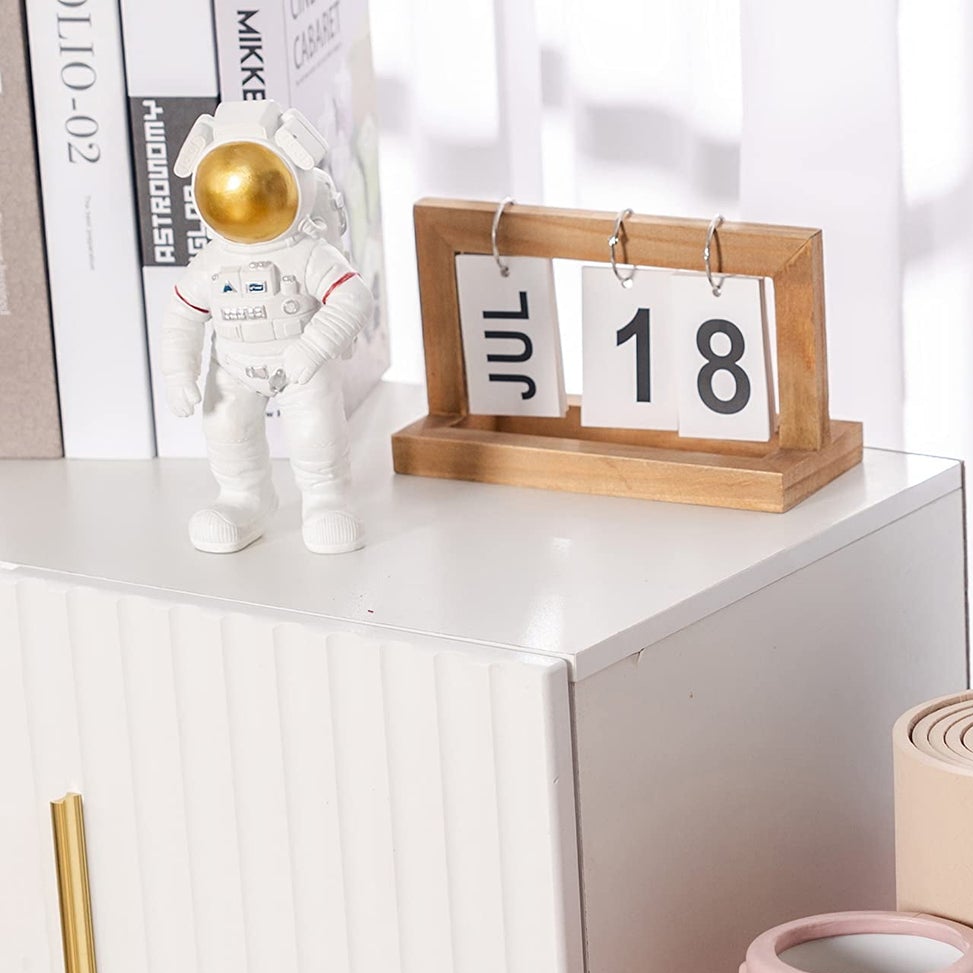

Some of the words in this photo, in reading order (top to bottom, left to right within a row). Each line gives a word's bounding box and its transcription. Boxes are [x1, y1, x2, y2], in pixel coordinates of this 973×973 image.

[56, 0, 102, 164] LIO-02
[142, 100, 176, 263] ASTRONOMY
[482, 291, 537, 400] JUL
